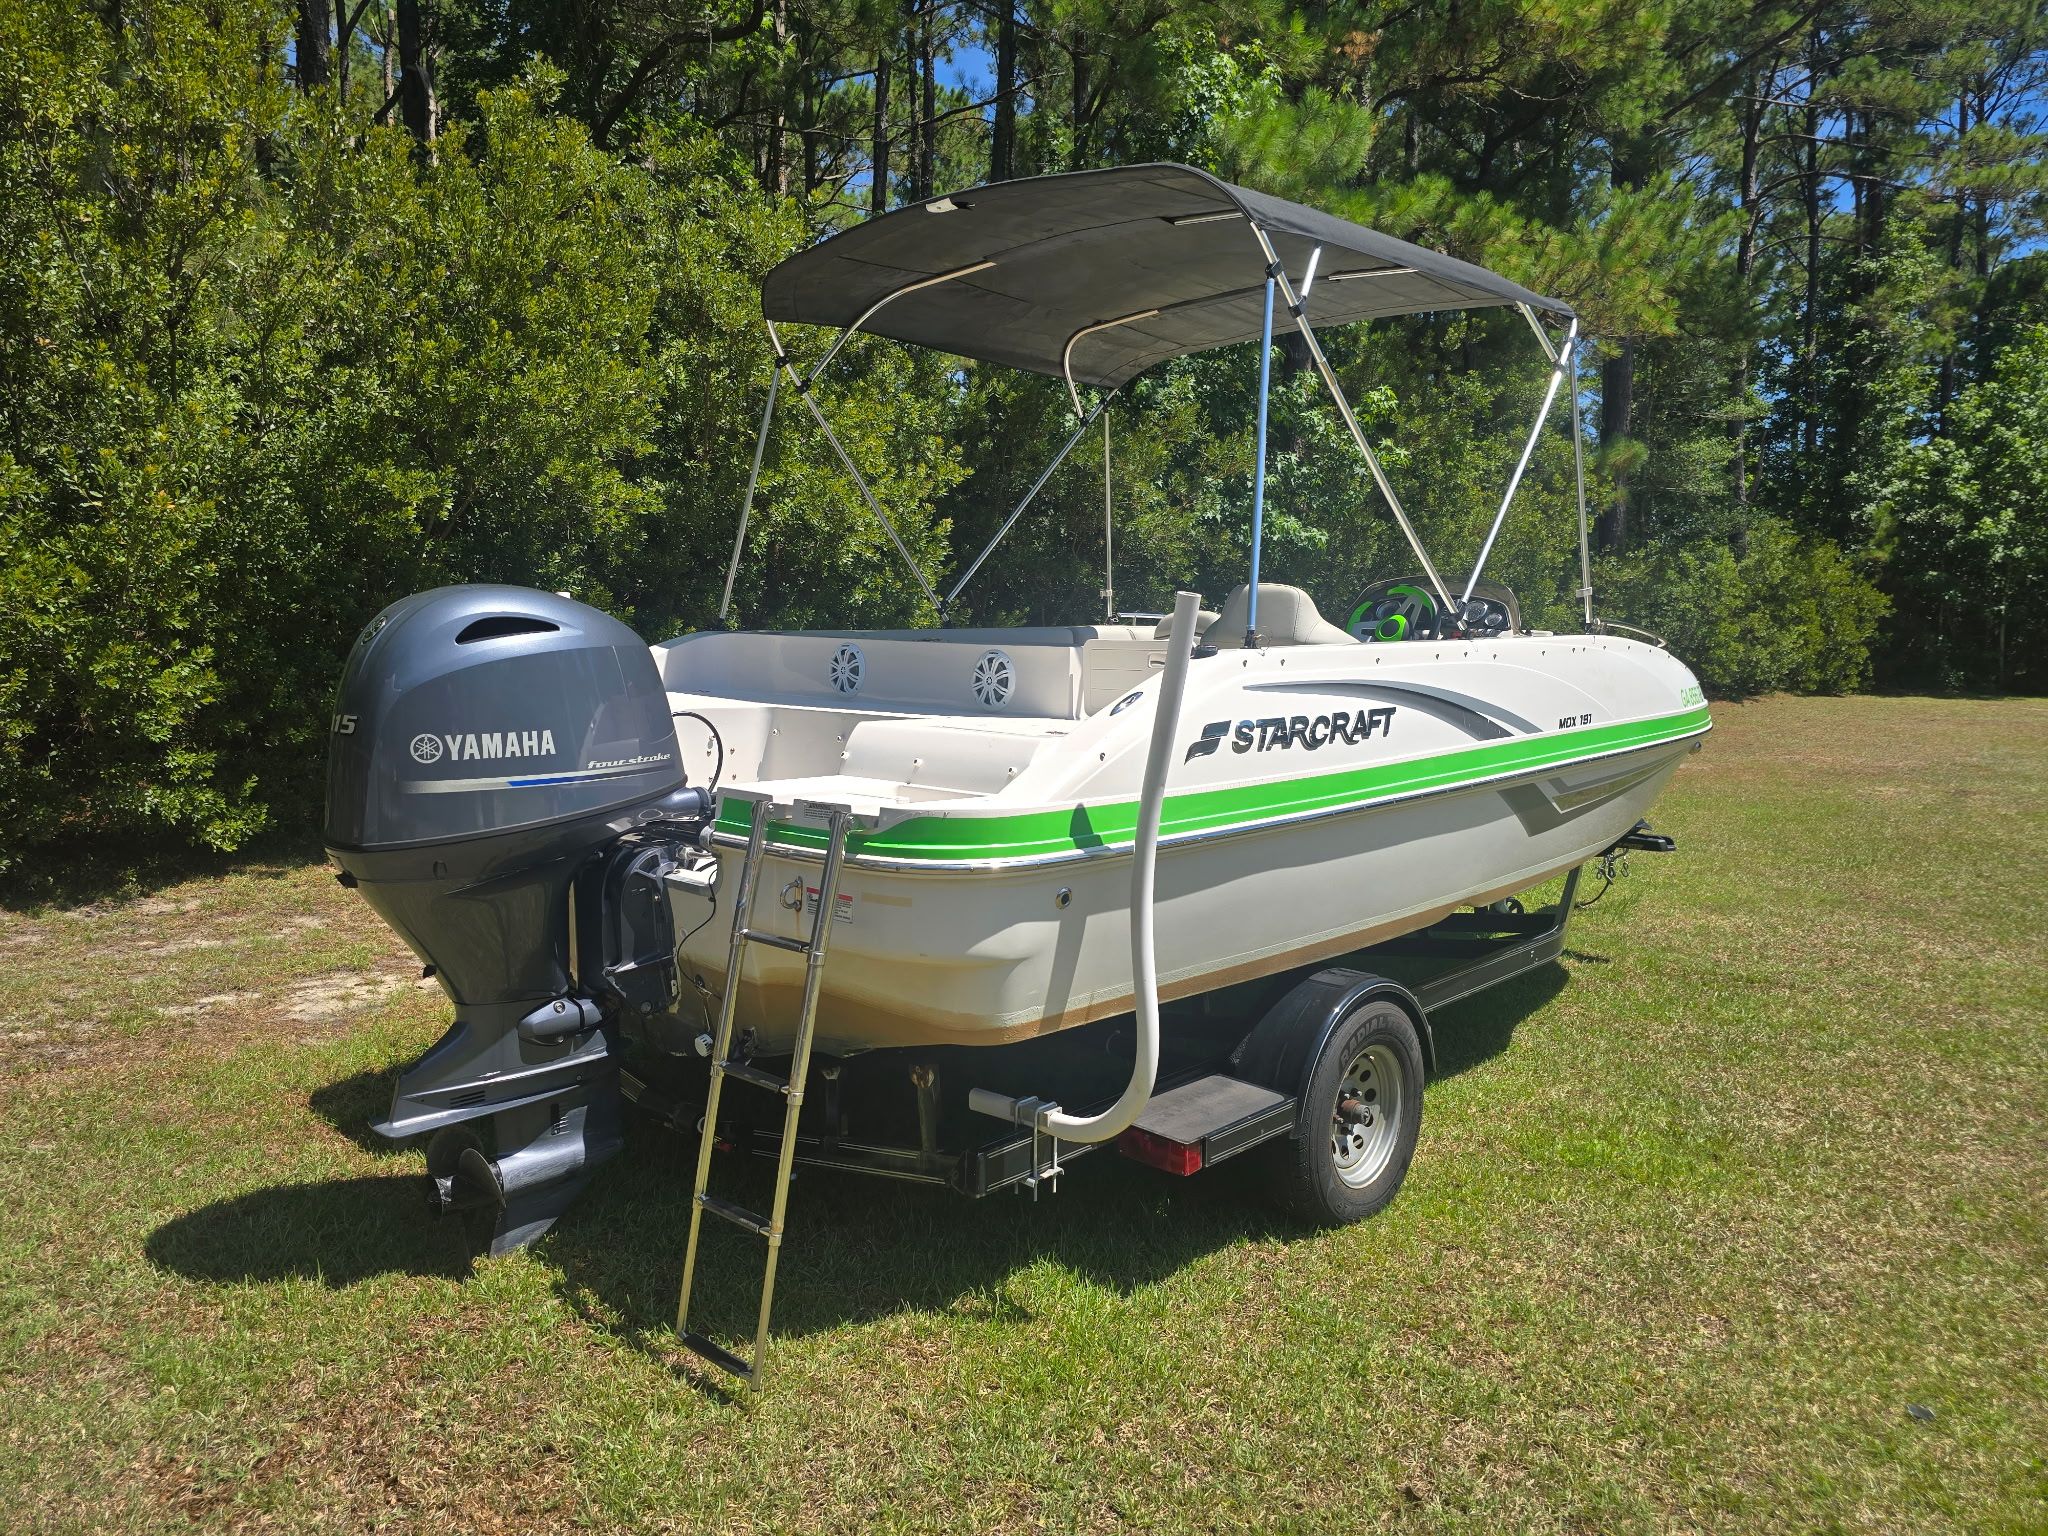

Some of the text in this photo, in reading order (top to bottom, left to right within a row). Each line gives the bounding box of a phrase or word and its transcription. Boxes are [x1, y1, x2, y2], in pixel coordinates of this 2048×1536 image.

[1231, 707, 1396, 754] STARCRAFT
[1559, 713, 1592, 730] MDX 191
[444, 729, 556, 761] YAMAHA
